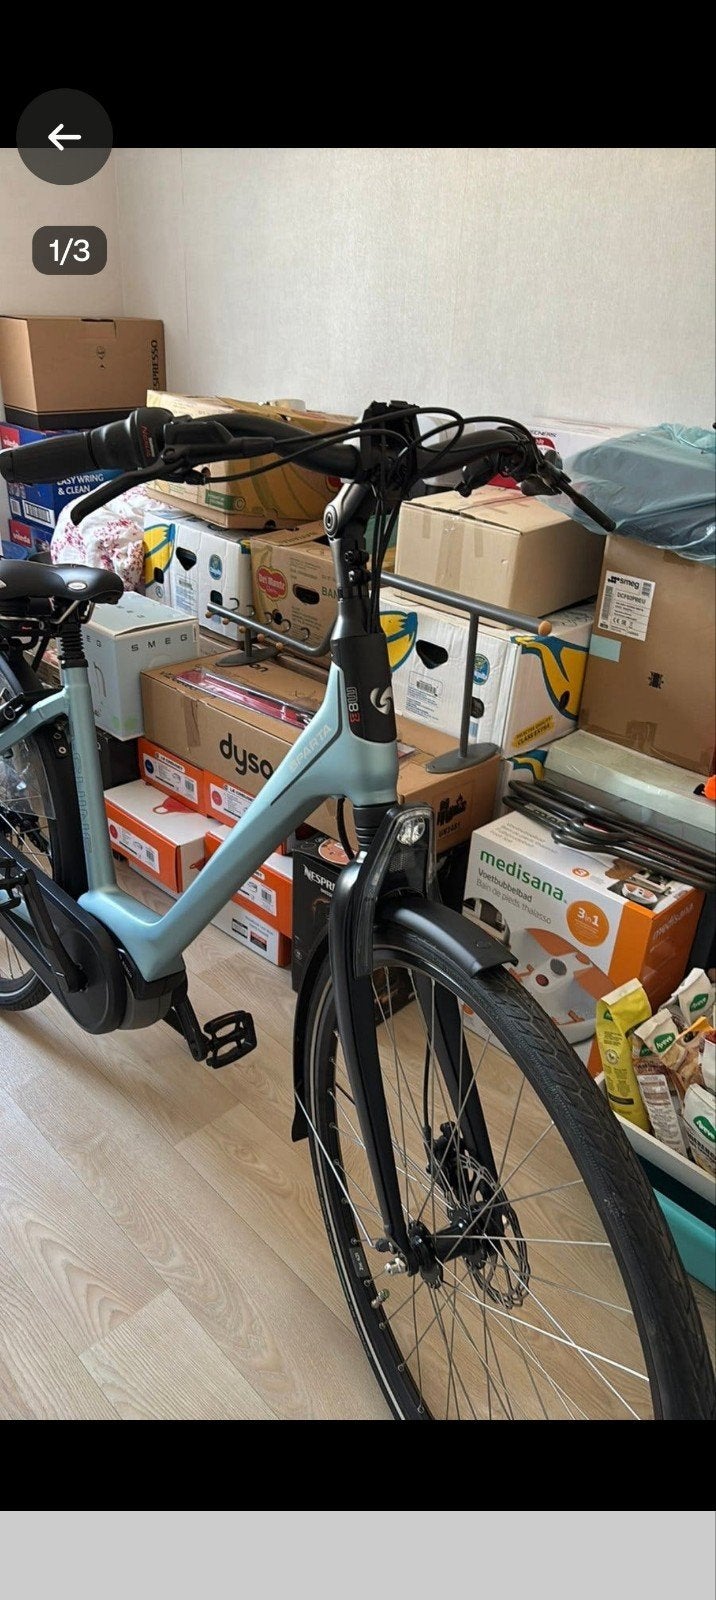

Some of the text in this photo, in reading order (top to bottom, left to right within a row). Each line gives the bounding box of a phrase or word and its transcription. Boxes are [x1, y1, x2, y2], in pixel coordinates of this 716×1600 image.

[151, 339, 160, 390] SPRESSO
[58, 486, 90, 496] & CLEAN
[76, 473, 104, 485] WRING
[321, 586, 338, 600] BAN
[619, 578, 640, 590] smeg
[219, 733, 274, 781] dyso
[290, 724, 333, 769] SPARTA
[302, 864, 336, 892] NESPR
[476, 879, 491, 891] Bain
[478, 867, 532, 903] Voetbubbelbad
[480, 850, 564, 901] medisana
